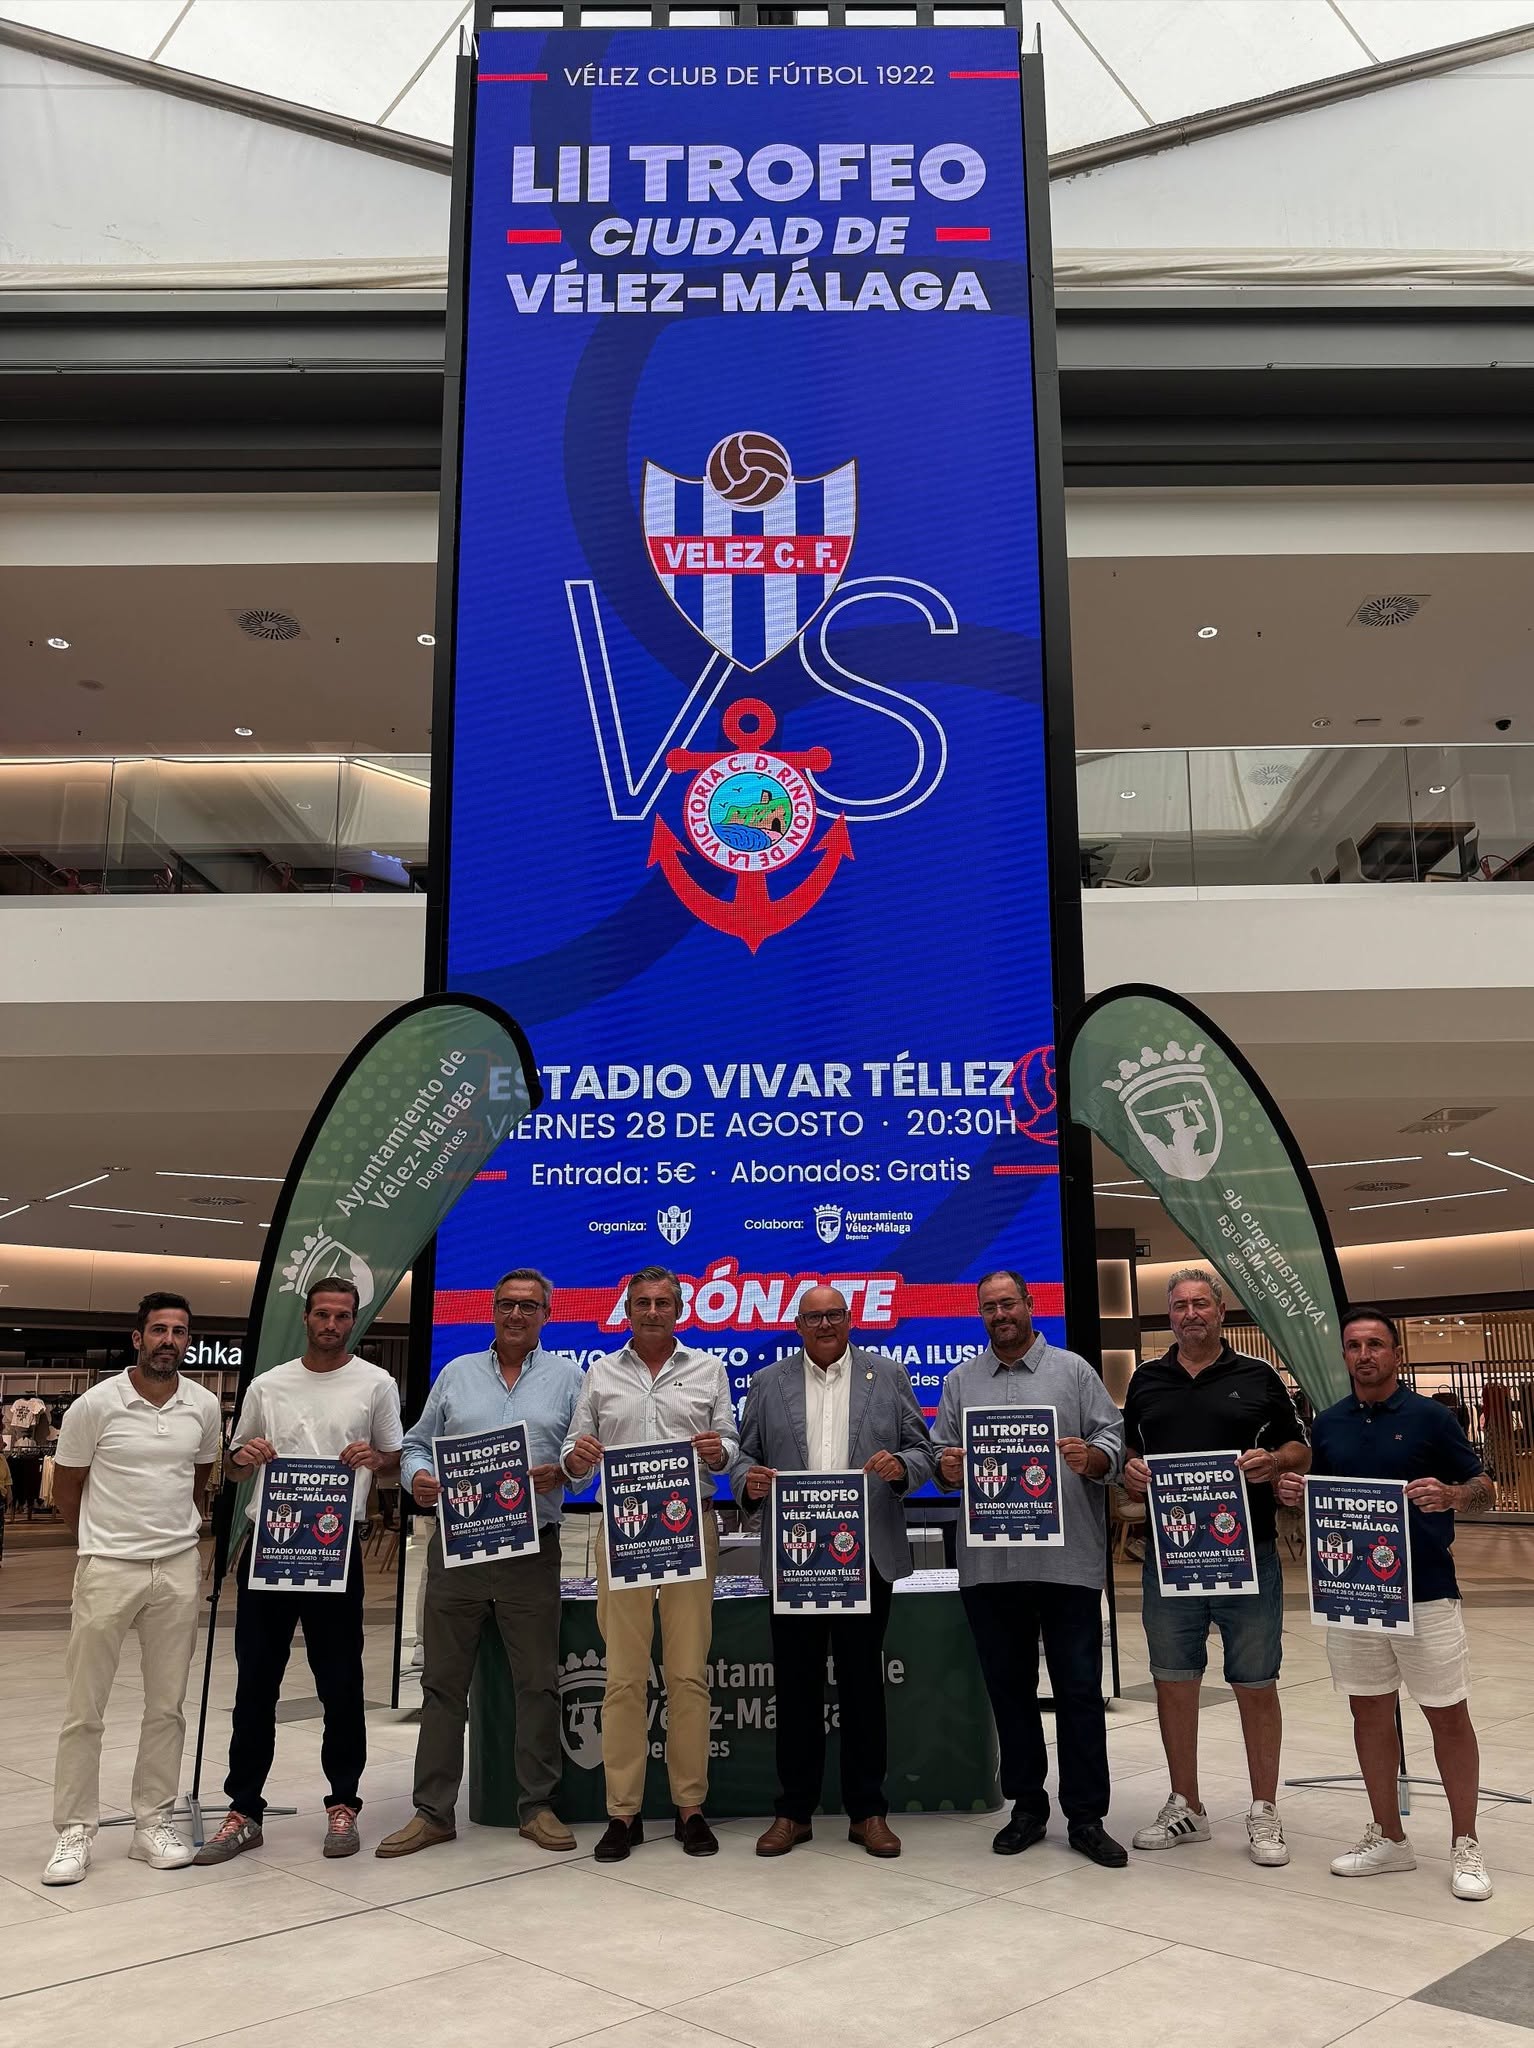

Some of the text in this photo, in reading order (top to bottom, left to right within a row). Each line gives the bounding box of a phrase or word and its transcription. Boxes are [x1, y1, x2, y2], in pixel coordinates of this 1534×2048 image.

[564, 61, 935, 87] VÉLEZ CLUB DE FÚTBOL 1922
[512, 143, 987, 203] LII TROFEO
[590, 216, 910, 256] CIUDAD DE
[505, 258, 991, 314] VÉLEZ-MÁLAGA
[663, 542, 838, 568] VELEZ C. F.
[690, 756, 810, 869] C. D. RINCON DE LA VICTORIA
[703, 1063, 852, 1098] VIVAR
[863, 1050, 1014, 1096] TÉLLEZ
[626, 1111, 666, 1139] 28
[676, 1112, 715, 1138] DE
[725, 1111, 864, 1137] AGOSTO
[907, 1109, 1016, 1136] 20:30H
[335, 1049, 466, 1217] Ayuntamiento de
[367, 1080, 476, 1211] Vélez-Málaga
[416, 1128, 468, 1191] Deportes
[532, 1157, 970, 1185] Entrada: 5€ Abonados: Gratis
[846, 1210, 913, 1222] Ayuntamiento
[589, 1221, 647, 1234] Organiza:
[744, 1219, 804, 1229] Colabora:
[846, 1222, 911, 1234] Vélez-Málaga
[972, 1424, 1048, 1437] LII TROFEO
[461, 1439, 520, 1460] TROFEO
[973, 1443, 1050, 1453] VÉLEZ-MÁLAGA
[445, 1459, 522, 1480] VÉLEZ-MÁLAGA
[611, 1457, 688, 1477] LII TROFEO
[270, 1471, 348, 1486] LII TROFEO
[1156, 1470, 1234, 1486] LII TROFEO
[612, 1479, 690, 1494] VÉLEZ-MÁLAGA
[269, 1490, 346, 1502] VÉLEZ-MÁLAGA
[782, 1489, 859, 1502] LII TROFEO
[1158, 1490, 1237, 1503] VÉLEZ-MÁLAGA
[1030, 1501, 1053, 1509] TÉLLEZ
[1315, 1496, 1397, 1514] LII TROFEO
[450, 1513, 527, 1531] ESTADIO VIVAR TÉLLEZ
[617, 1516, 634, 1524] VELEZ
[782, 1509, 859, 1520] VÉLEZ-MÁLAGA
[1316, 1517, 1399, 1533] VÉLEZ-MÁLAGA
[616, 1536, 694, 1551] ESTADIO VIVAR TÉLLEZ
[262, 1547, 293, 1555] ESTADIO
[318, 1548, 341, 1556] TÉLLEZ
[1221, 1549, 1244, 1557] TÉLLEZ
[837, 1568, 860, 1576] TÉLLEZ
[1319, 1580, 1401, 1594] ESTADIO VIVAR TÉLLEZ
